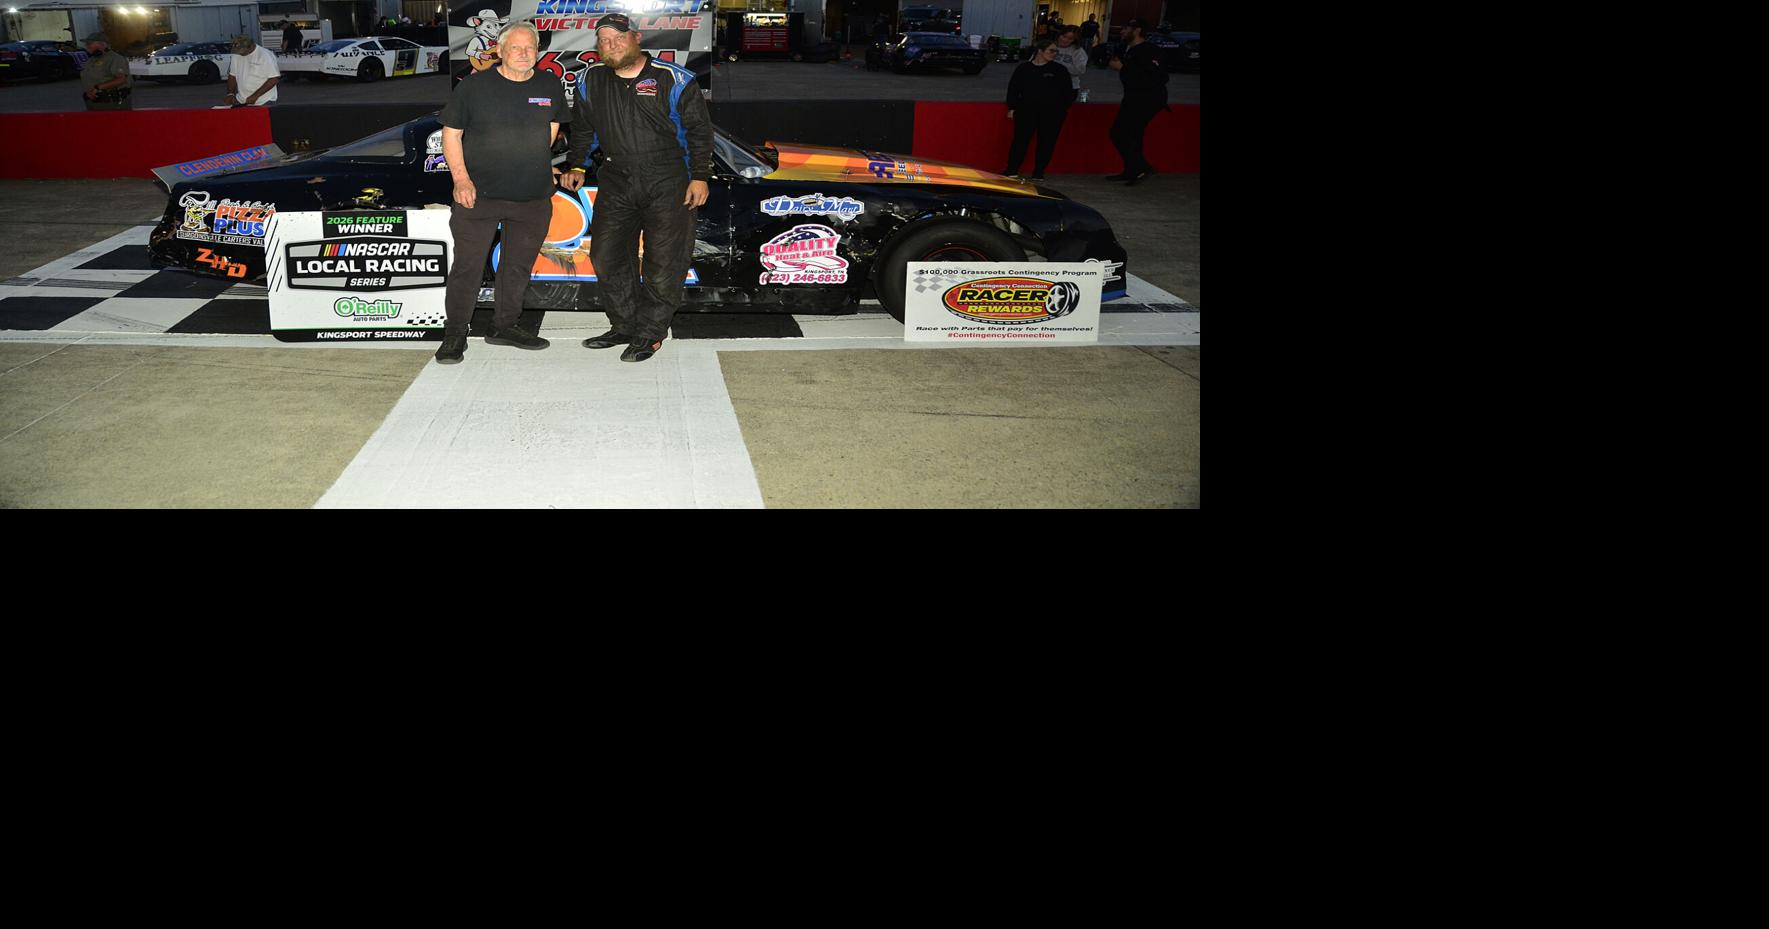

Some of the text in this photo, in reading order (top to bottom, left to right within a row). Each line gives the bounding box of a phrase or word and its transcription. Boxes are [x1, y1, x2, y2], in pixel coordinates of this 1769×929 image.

[535, 0, 702, 14] KINGSORT
[639, 17, 703, 30] LANE
[327, 216, 404, 225] 2026 FEATURE
[213, 218, 265, 237] PLUS
[338, 224, 394, 234] WINNER
[344, 243, 411, 257] NASCAR
[762, 237, 838, 255] QUALITY
[776, 253, 800, 261] Heat
[812, 249, 834, 258] Aire
[296, 258, 440, 274] LOCAL RACING
[349, 277, 387, 287] SERIES
[793, 273, 847, 282] 246-6833
[958, 289, 1050, 302] RACER
[336, 298, 400, 316] O'Reilly
[967, 305, 1043, 313] REWARDS
[316, 330, 426, 339] KINGSPORT SPEEDWAY
[947, 332, 1056, 340] #ContingencyConnection
